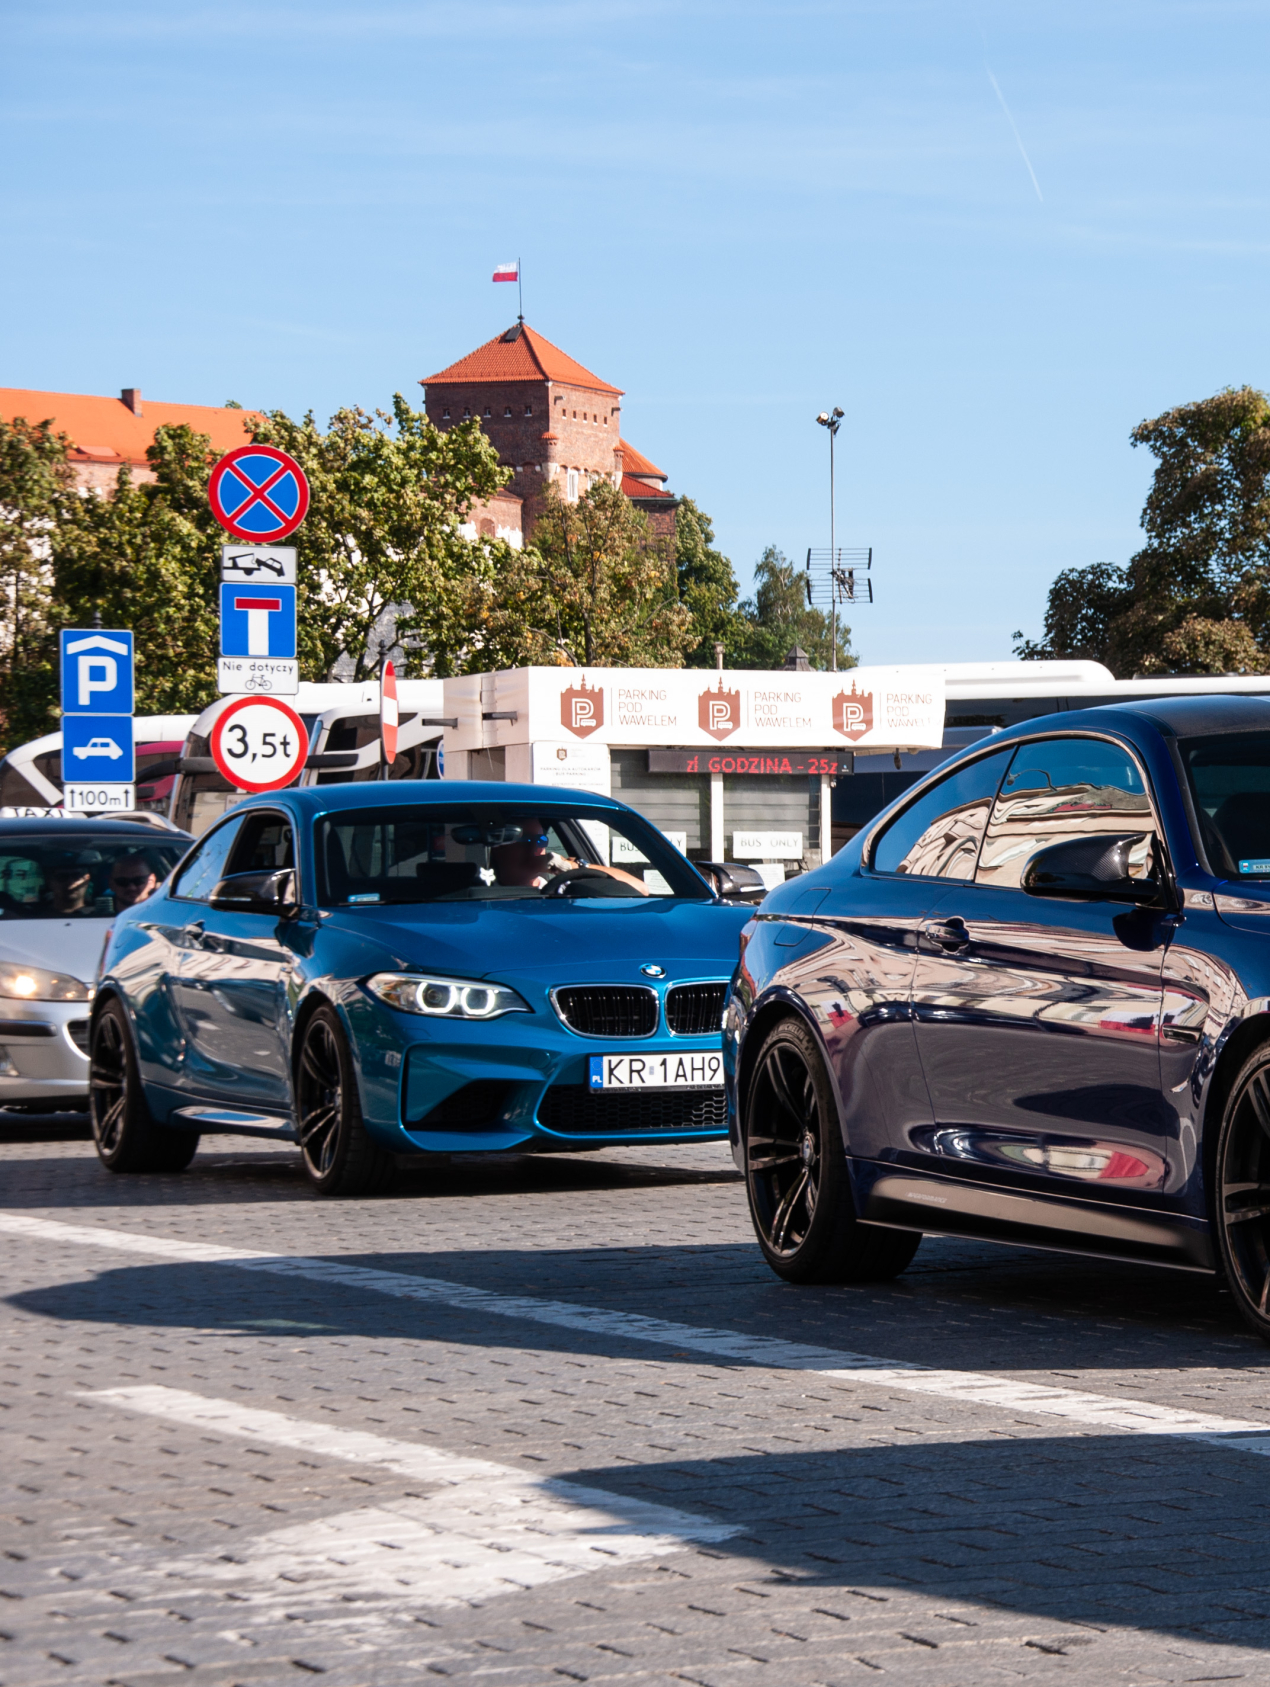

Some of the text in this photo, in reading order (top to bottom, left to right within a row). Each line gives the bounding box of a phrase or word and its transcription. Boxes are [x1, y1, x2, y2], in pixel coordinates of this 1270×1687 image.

[223, 661, 294, 675] Nie dotyczy
[78, 655, 117, 706] P
[618, 689, 667, 701] PARKING
[754, 692, 802, 703] PARKING
[886, 693, 933, 705] PARKING
[618, 702, 643, 713] POD
[754, 704, 778, 715] POD
[886, 706, 909, 717] POD
[618, 715, 677, 726] WAWELEM
[754, 717, 812, 728] WAWELEM
[227, 723, 292, 764] 3,5t
[708, 757, 793, 774] GODZINA
[620, 842, 640, 852] BU
[740, 838, 800, 848] BUS ONLY
[607, 1058, 646, 1085] KR
